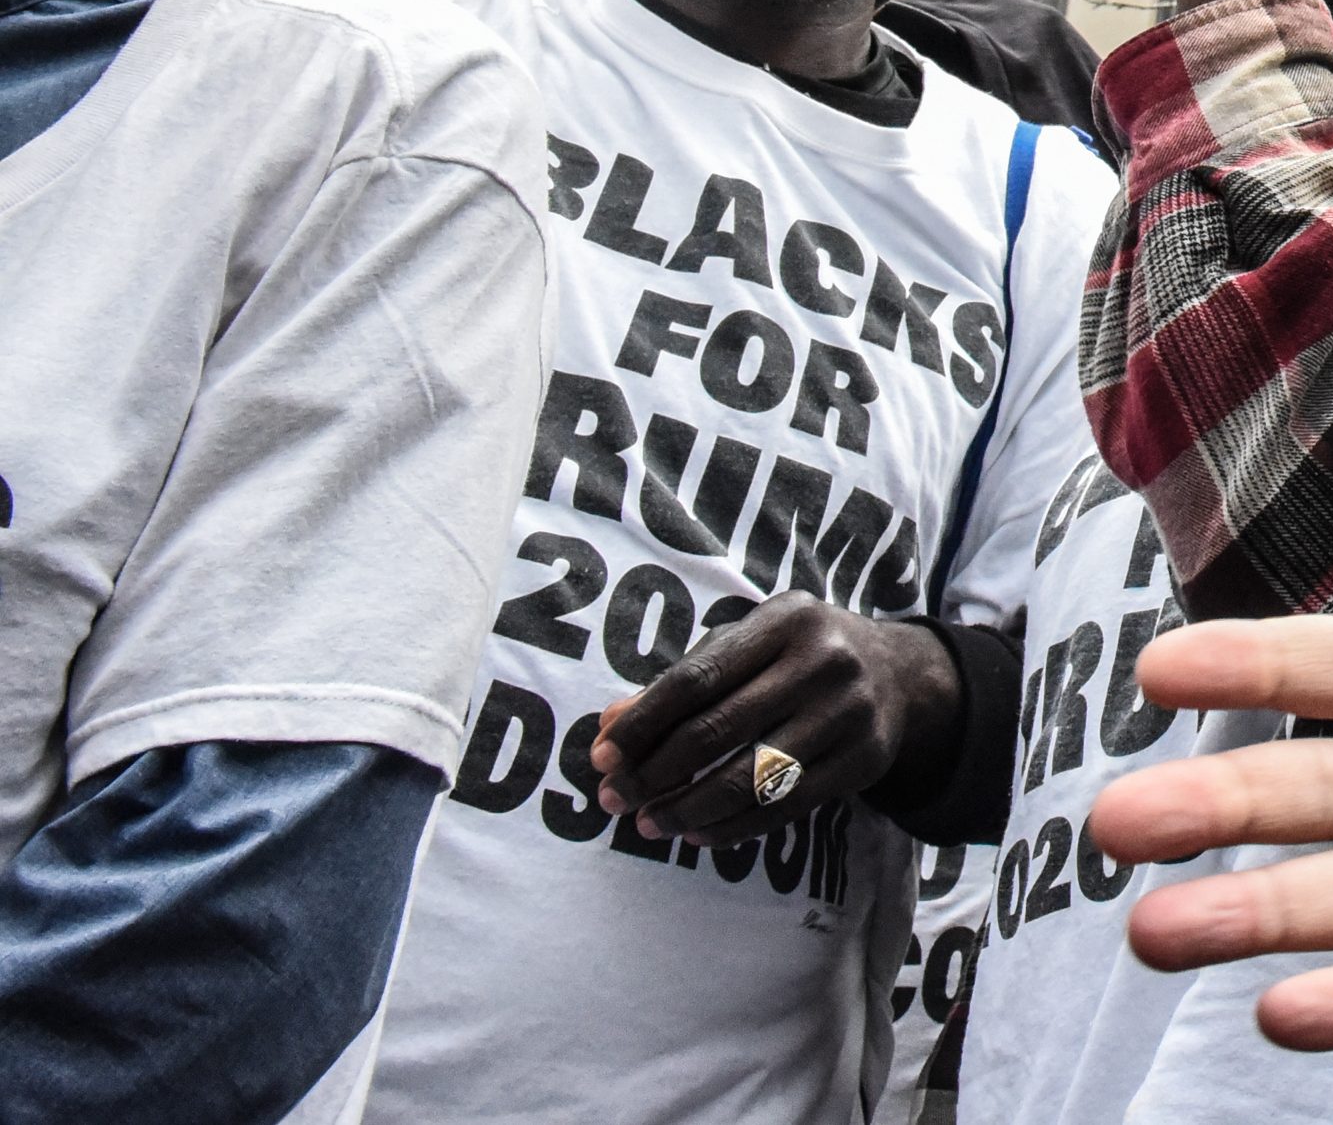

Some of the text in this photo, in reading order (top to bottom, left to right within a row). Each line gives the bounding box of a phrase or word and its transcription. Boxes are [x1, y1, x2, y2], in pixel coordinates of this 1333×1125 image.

[547, 130, 1005, 408] BLACKS
[614, 288, 880, 457] FOR
[524, 369, 922, 618] RUMP
